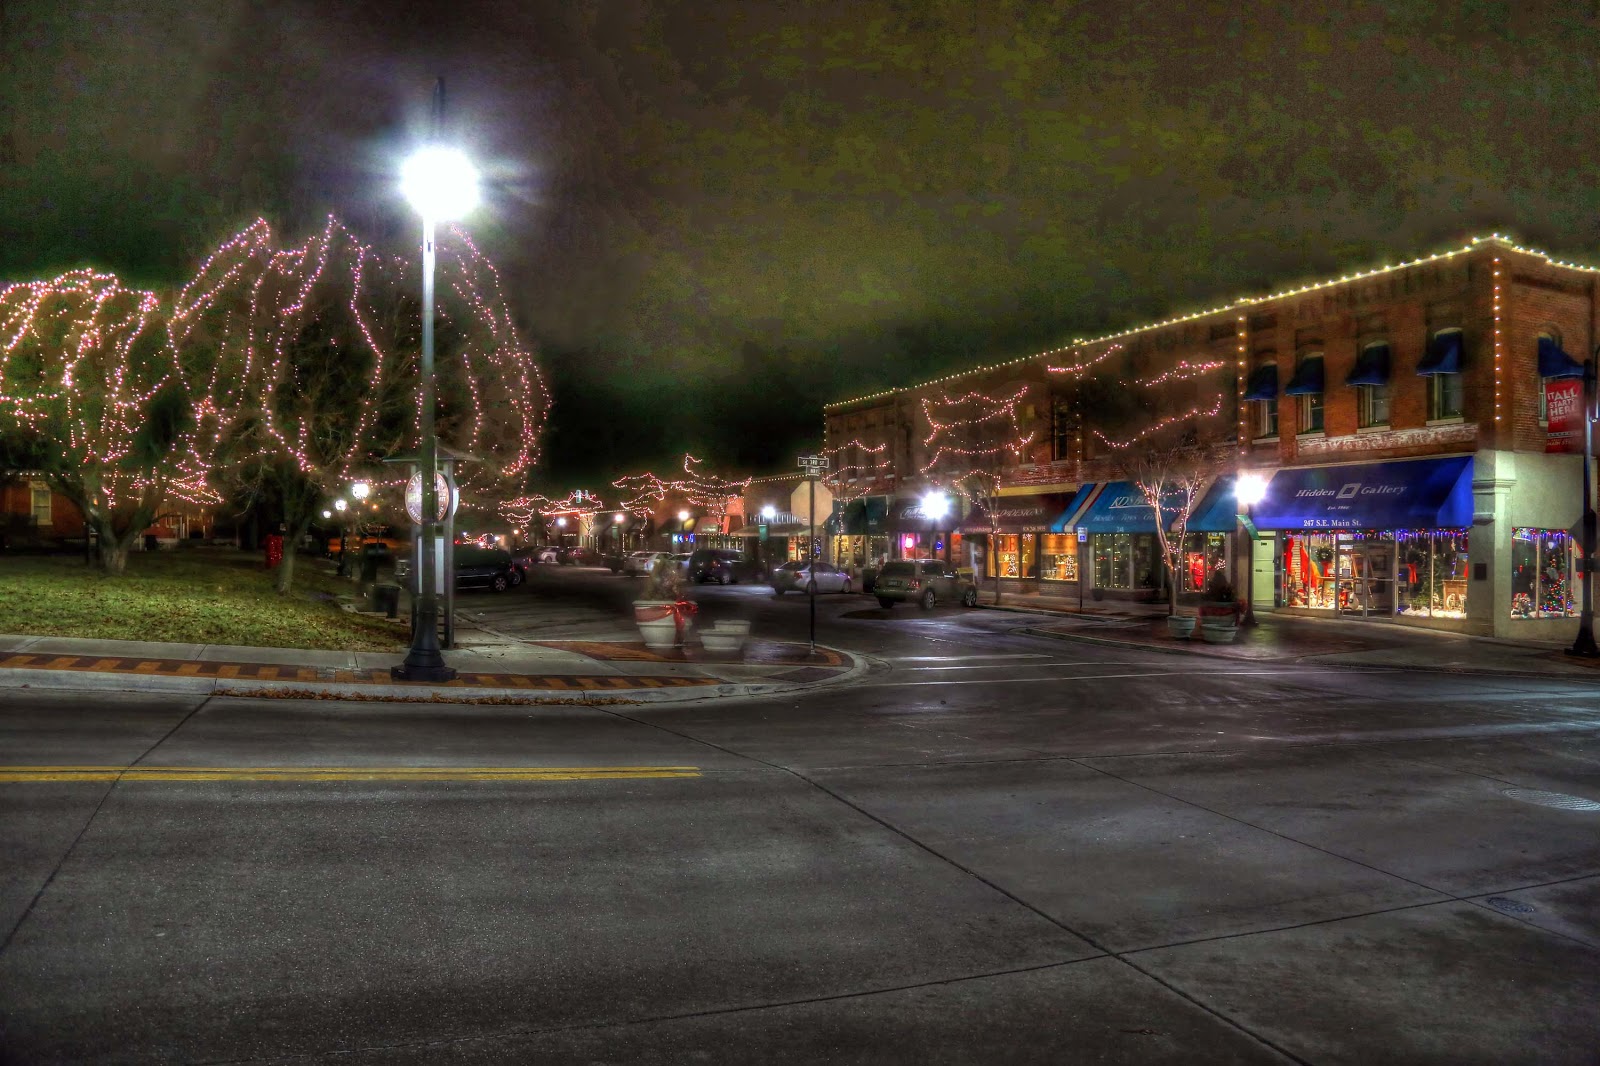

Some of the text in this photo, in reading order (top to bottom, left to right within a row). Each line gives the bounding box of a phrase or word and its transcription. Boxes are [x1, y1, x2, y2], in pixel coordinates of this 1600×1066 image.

[1555, 388, 1577, 401] ALL
[1296, 485, 1408, 497] Hidden Gallery
[1303, 519, 1362, 527] 247 S.E. Main St.
